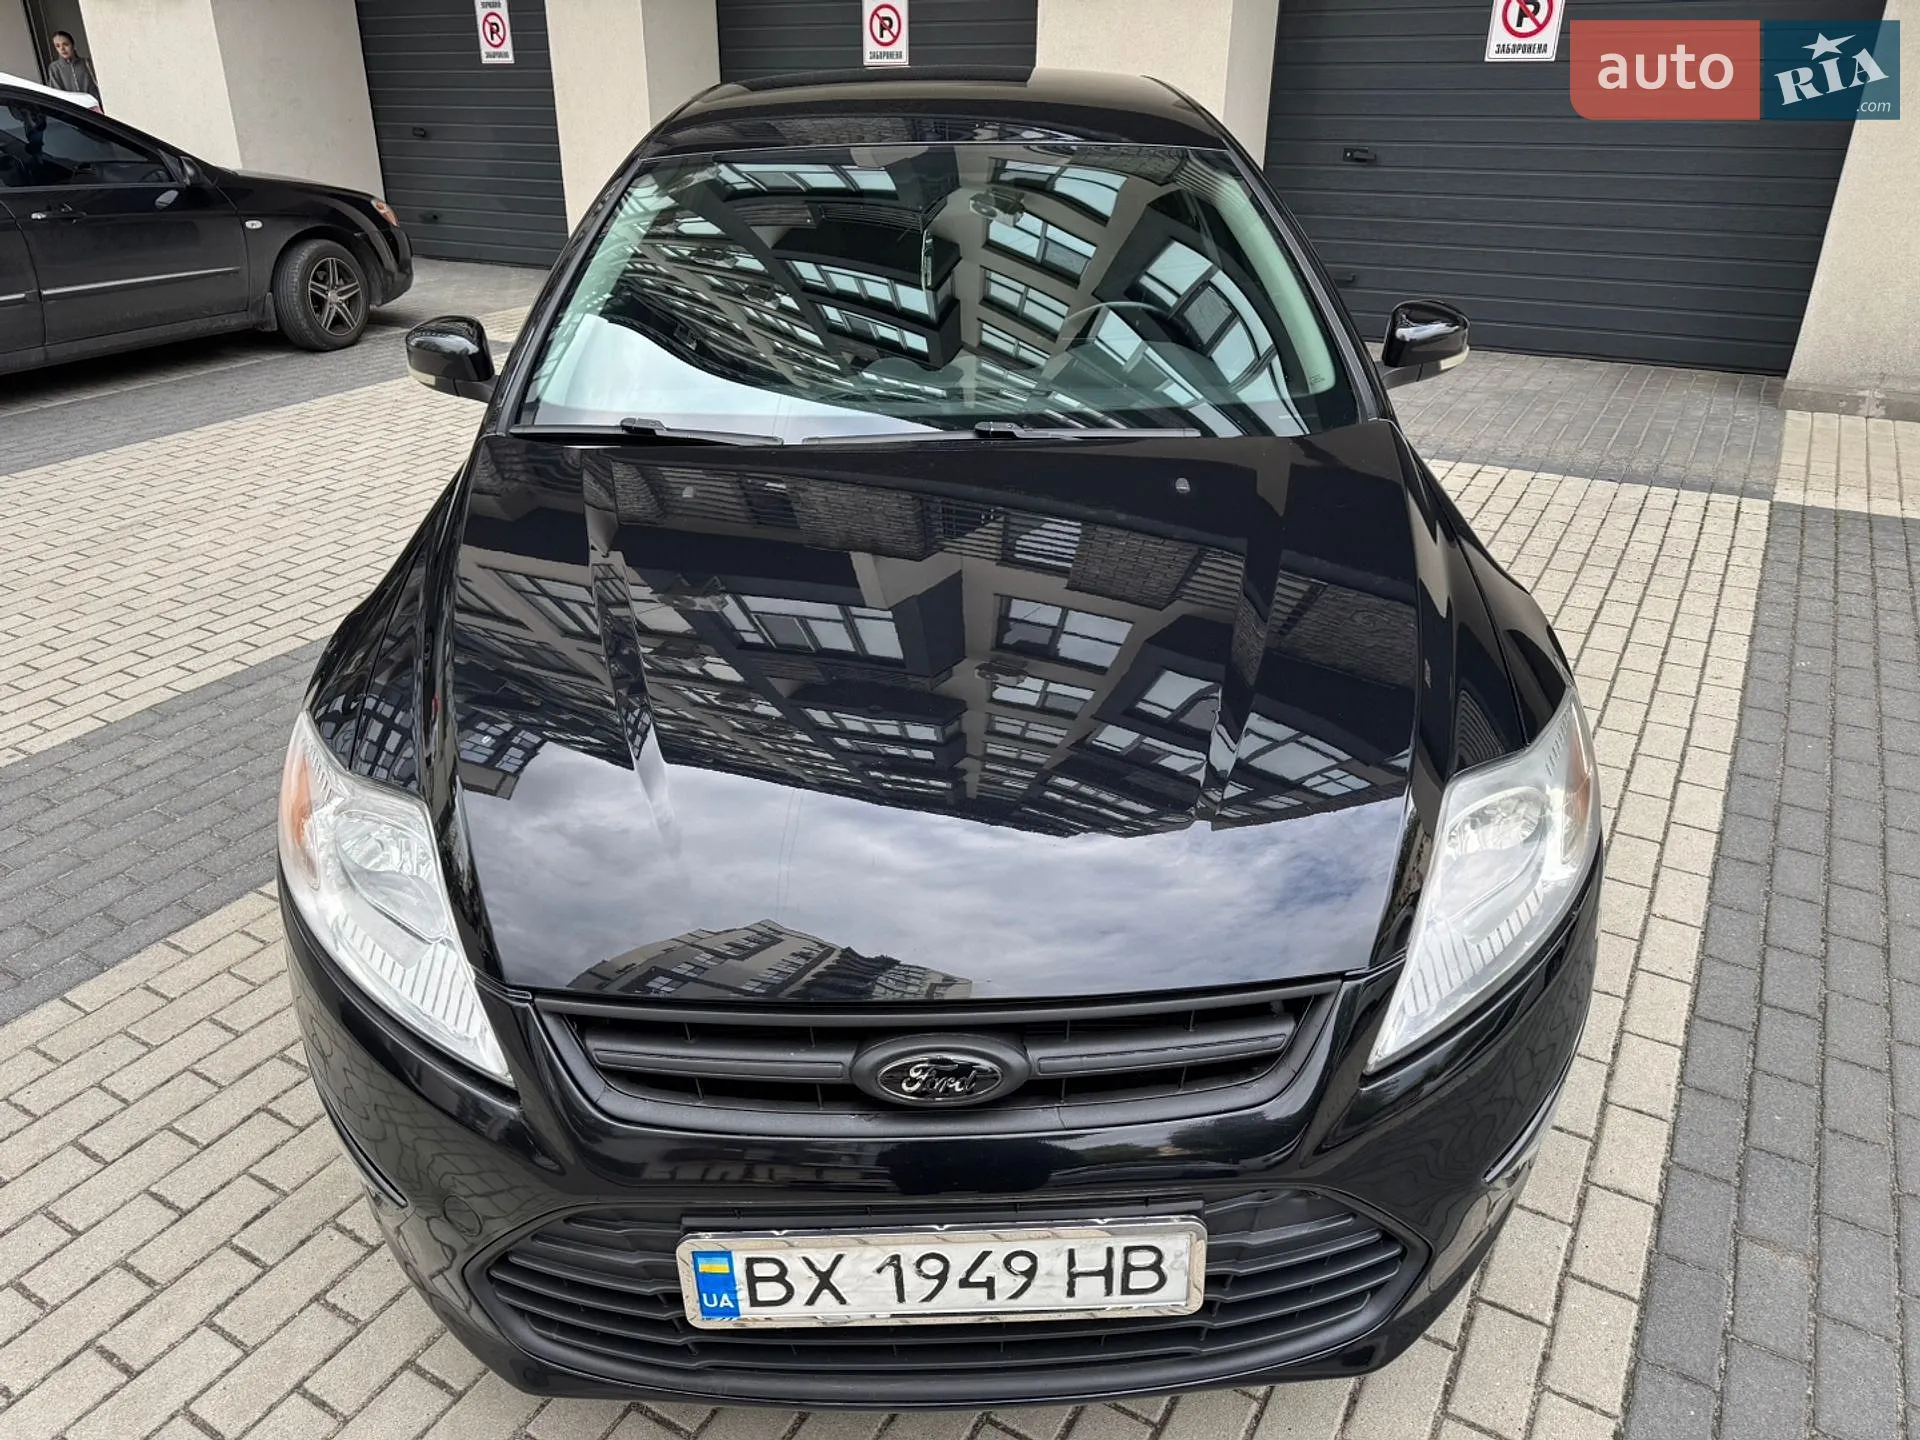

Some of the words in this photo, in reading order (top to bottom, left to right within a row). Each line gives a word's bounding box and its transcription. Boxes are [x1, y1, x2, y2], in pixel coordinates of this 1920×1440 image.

[1495, 43, 1548, 55] ЗАБОРОНЕНА
[901, 1061, 977, 1094] Ford
[745, 1253, 847, 1308] BX
[873, 1249, 1040, 1305] 1949
[1066, 1244, 1169, 1299] HB
[703, 1292, 734, 1310] UA
